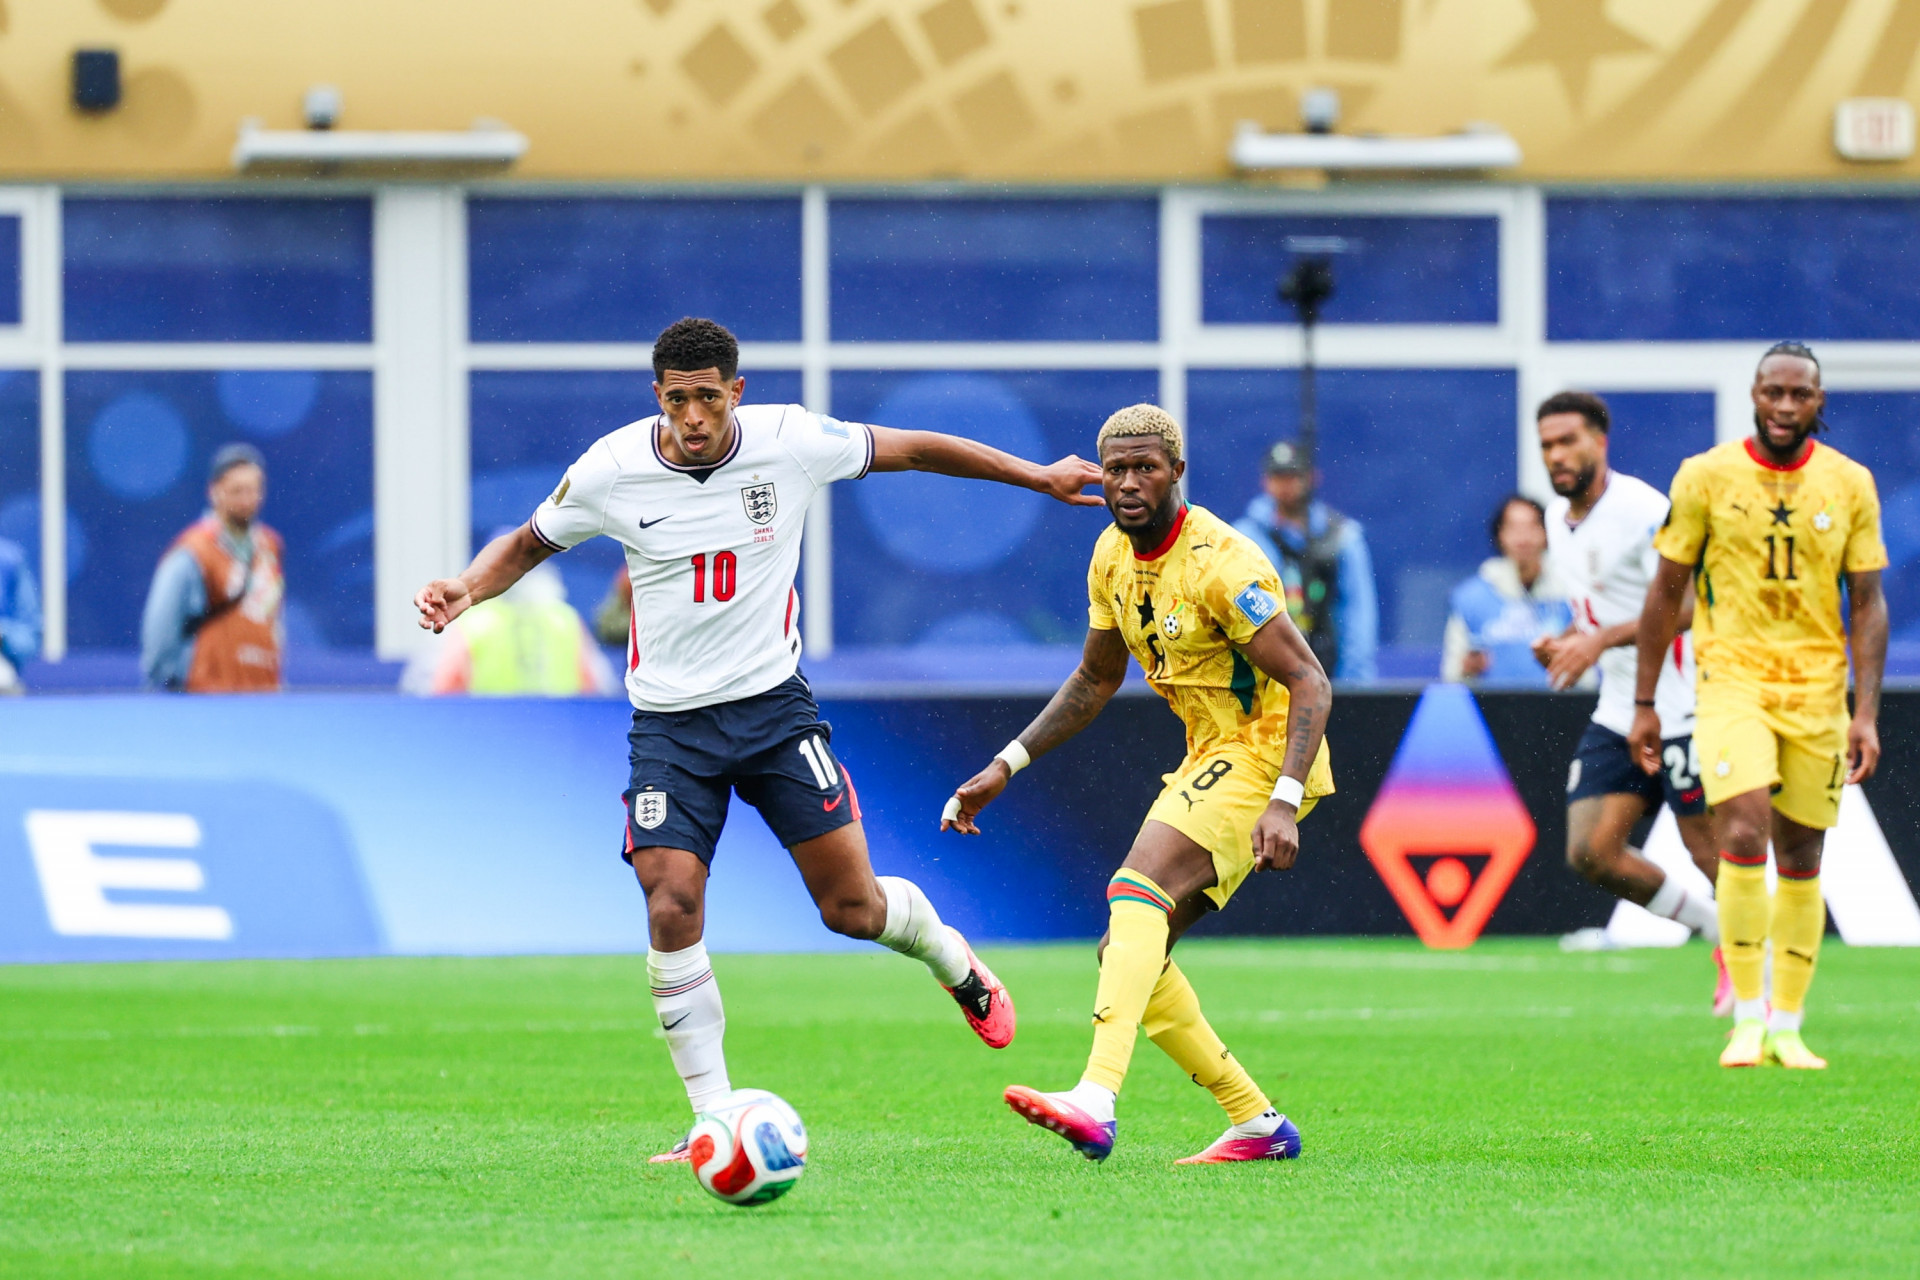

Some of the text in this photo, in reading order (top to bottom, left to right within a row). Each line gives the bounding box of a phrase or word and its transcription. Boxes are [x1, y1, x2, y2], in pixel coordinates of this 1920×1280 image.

[753, 527, 774, 535] GHANA
[691, 550, 736, 603] 10
[1765, 535, 1797, 580] 11
[1192, 759, 1233, 791] 8
[24, 808, 233, 940] E
